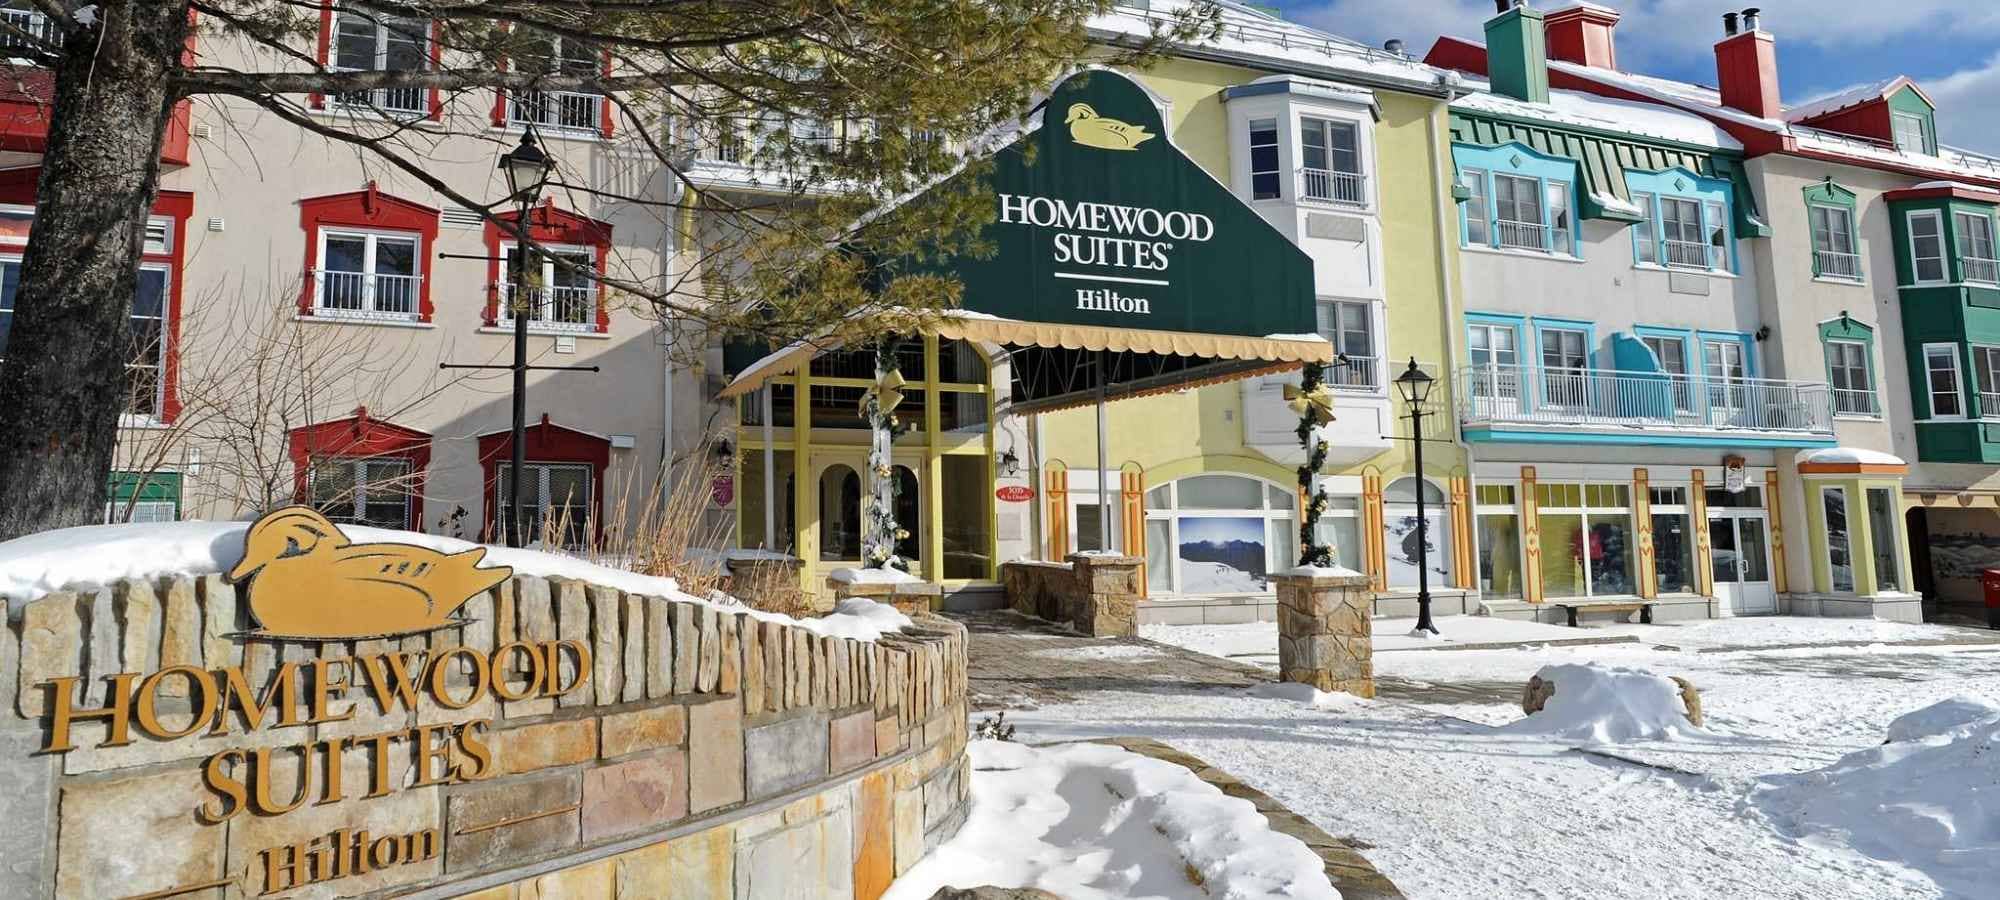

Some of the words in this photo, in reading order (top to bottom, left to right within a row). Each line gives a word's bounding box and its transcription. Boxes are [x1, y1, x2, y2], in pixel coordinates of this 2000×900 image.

[999, 194, 1214, 242] HOMEWOOD
[1076, 289, 1151, 314] Hilton
[33, 638, 592, 756] HOMEWOOD
[199, 718, 493, 826] SUITES
[257, 827, 440, 896] Hilton
